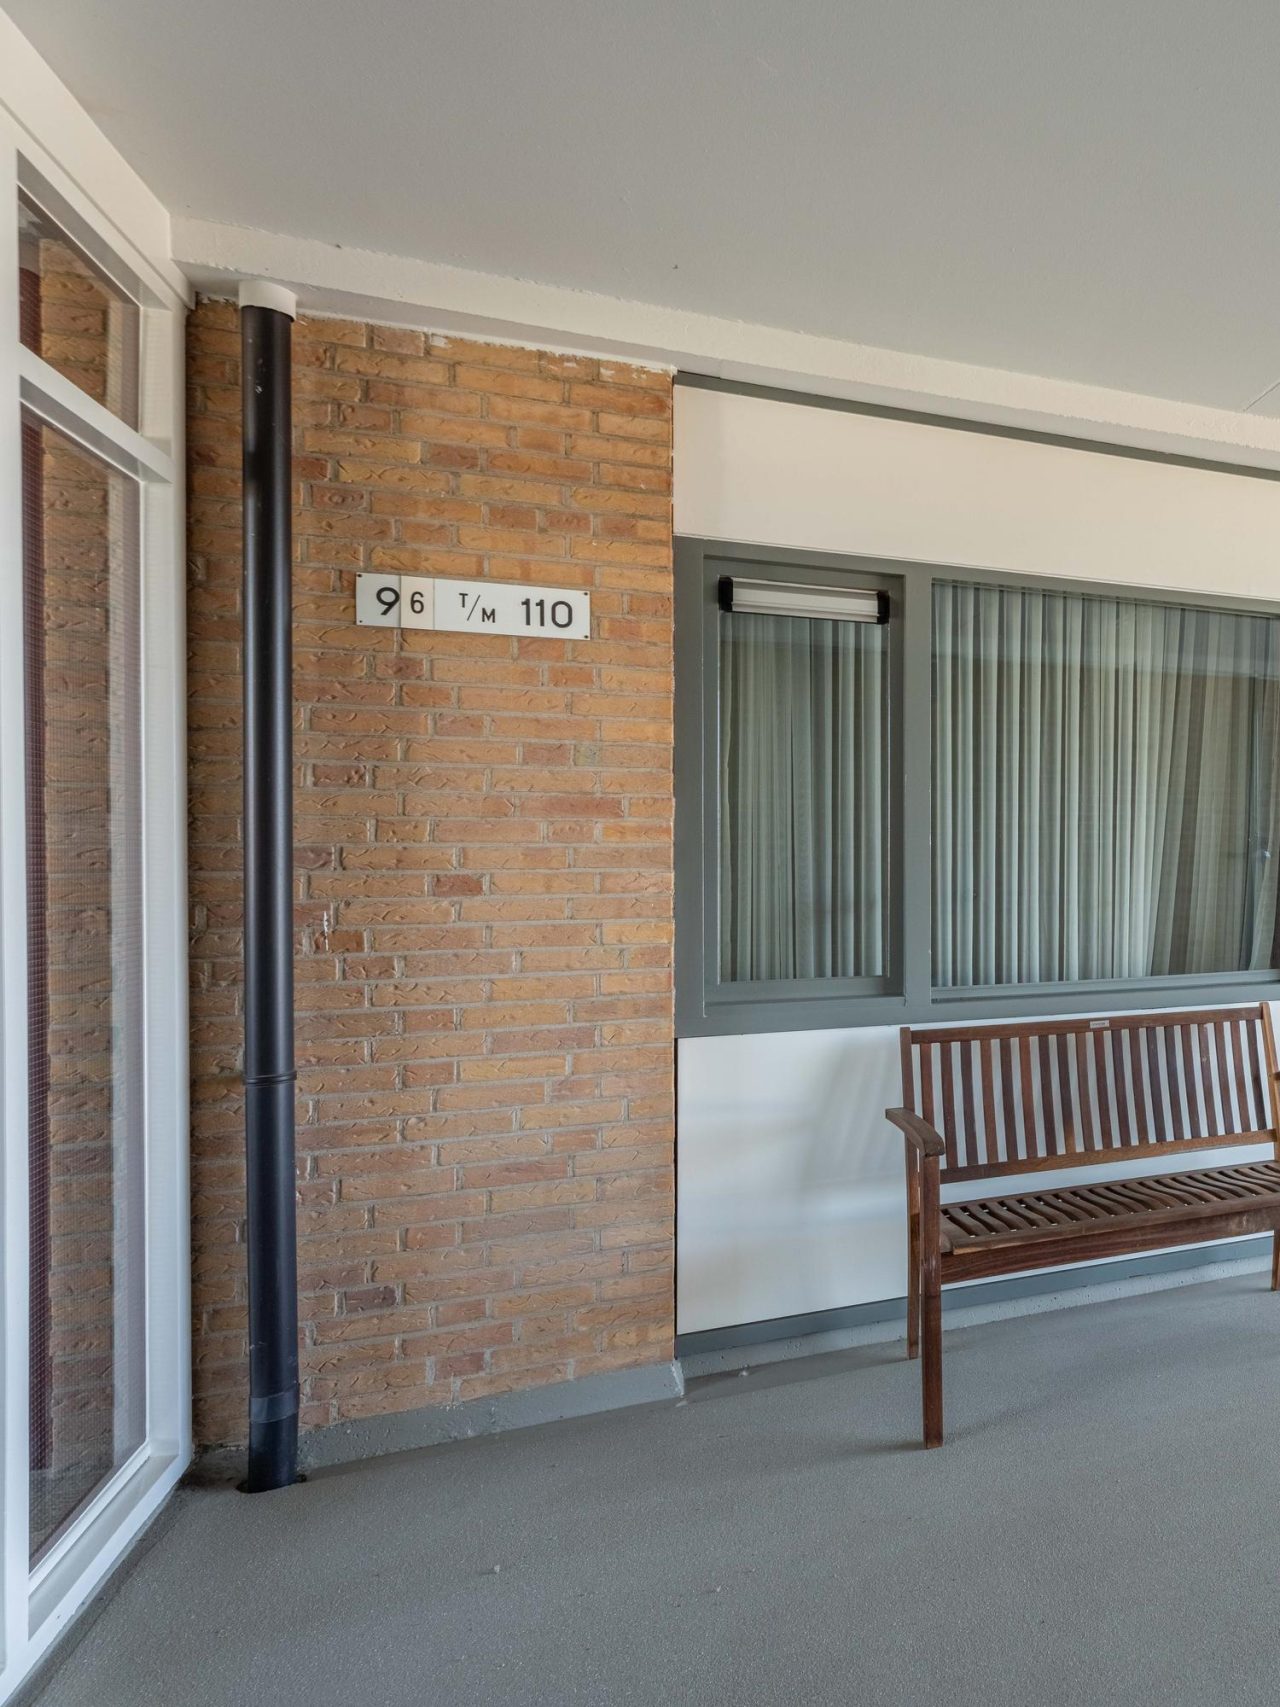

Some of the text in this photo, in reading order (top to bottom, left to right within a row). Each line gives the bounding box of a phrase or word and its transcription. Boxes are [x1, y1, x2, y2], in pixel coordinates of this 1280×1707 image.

[376, 586, 573, 629] 96 T/M 110
